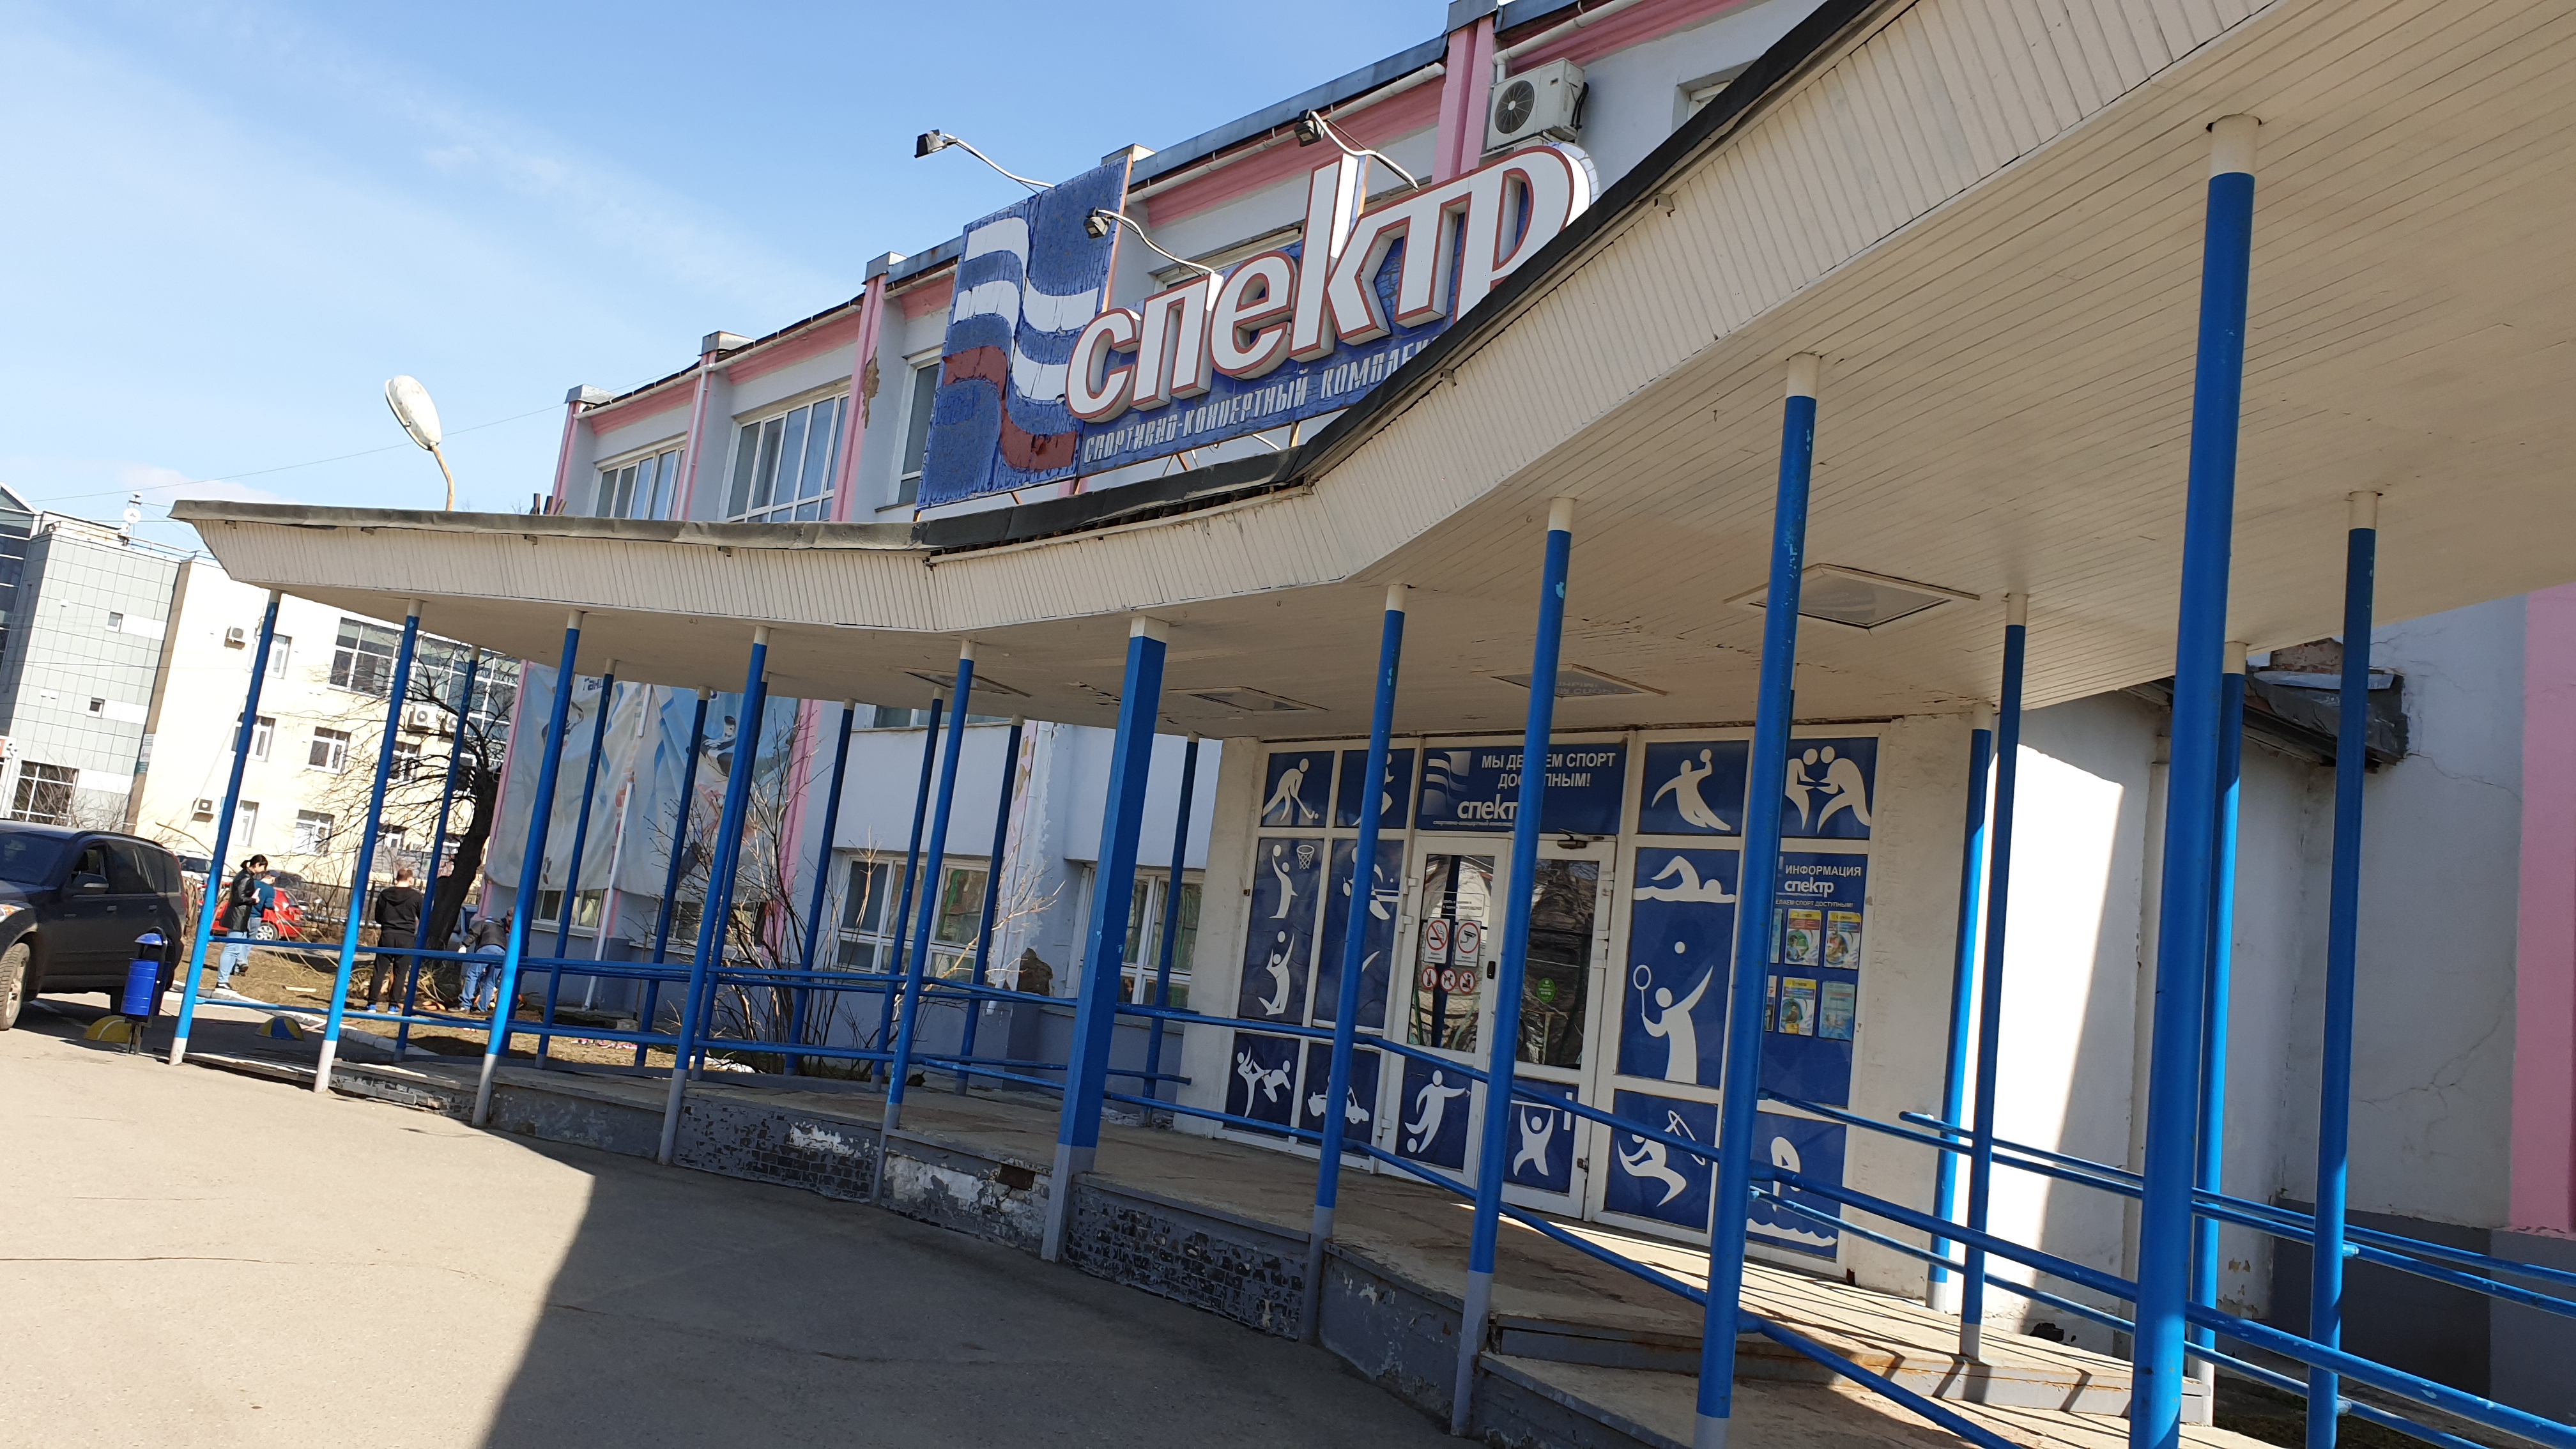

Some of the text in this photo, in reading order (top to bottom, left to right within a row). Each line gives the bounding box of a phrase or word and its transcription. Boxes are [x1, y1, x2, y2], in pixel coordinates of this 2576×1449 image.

[1084, 335, 1440, 463] СПОРТИВНО-КОНЦЕРТНЫЙ КОМПЛЕ
[1482, 753, 1616, 770] МЫ ДЕЕМ СПОРТ
[1457, 793, 1519, 820] спект
[1785, 864, 1862, 877] ИНФОРМАЦИЯ
[1784, 877, 1834, 898] спектр
